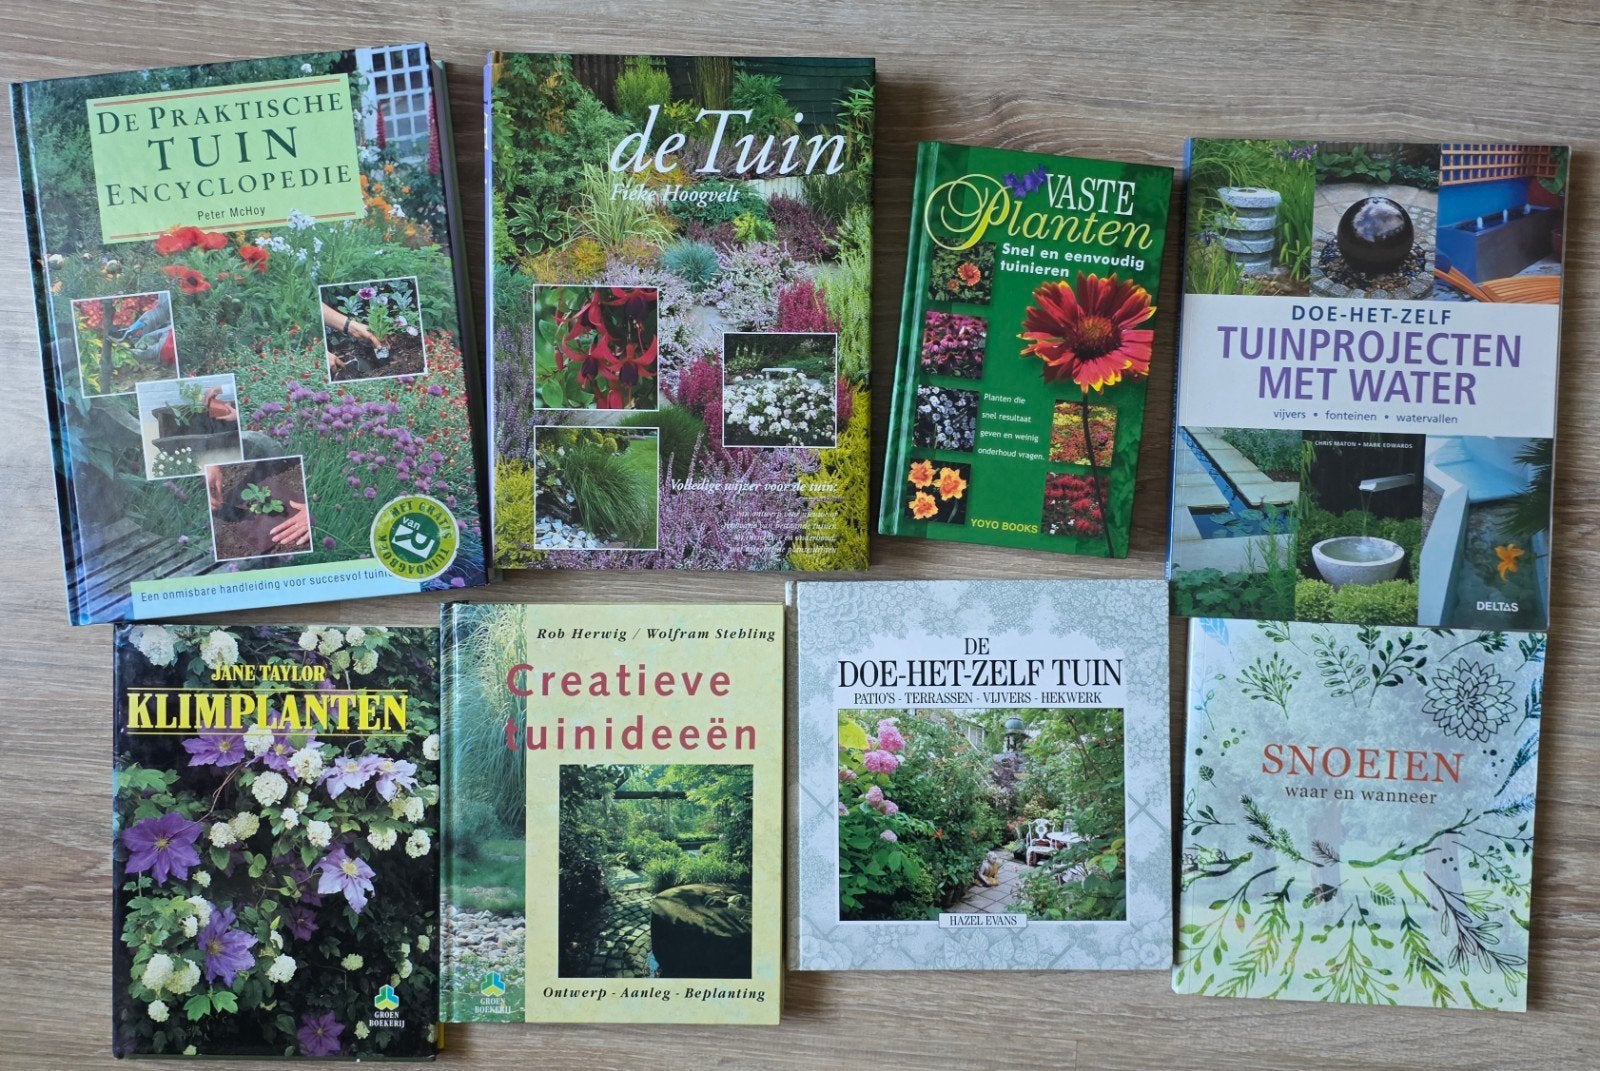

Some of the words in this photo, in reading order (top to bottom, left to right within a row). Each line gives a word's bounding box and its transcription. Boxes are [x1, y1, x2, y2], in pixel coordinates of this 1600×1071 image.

[610, 104, 686, 173] de
[694, 107, 847, 175] Tuin
[148, 126, 298, 171] TUIN
[610, 183, 656, 201] Fieke
[663, 184, 740, 207] Hoogvelt
[1045, 173, 1136, 216] VASTE
[197, 208, 225, 222] Peter
[230, 205, 266, 220] McHoy
[924, 173, 1153, 250] Planten
[1002, 242, 1035, 257] Snel
[1040, 249, 1060, 260] en
[1064, 251, 1145, 272] eenvoudig
[1000, 260, 1070, 278] tuinieren
[1291, 305, 1452, 326] DOE-HET-ZELF
[1216, 325, 1522, 368] TUINPROJECTEN
[1258, 366, 1337, 400] MET
[1348, 368, 1477, 405] WATER
[983, 393, 1012, 403] Planten
[1013, 396, 1026, 405] die
[981, 412, 997, 420] snel
[998, 414, 1032, 423] resultaat
[1273, 409, 1306, 421] vijvers
[1324, 410, 1377, 422] fonteinen
[1396, 413, 1458, 424] watervallen
[980, 430, 1002, 438] geven
[1015, 433, 1039, 443] weinig
[977, 447, 1017, 458] onderhoud
[1018, 452, 1045, 461] vragen.
[671, 478, 721, 494] Volledige
[724, 482, 759, 494] wijzer
[765, 483, 790, 492] voor
[792, 480, 807, 492] de
[390, 501, 413, 517] MET
[402, 517, 420, 530] van
[971, 518, 999, 529] YOYO
[1002, 521, 1038, 534] BOOKS
[141, 591, 160, 602] Een
[162, 586, 217, 600] onmisbare
[220, 579, 281, 595] handleiding
[283, 577, 306, 588] voor
[309, 569, 362, 586] succesvol
[1476, 601, 1519, 612] DELTAS
[537, 628, 566, 640] Rob
[571, 628, 627, 642] Herwig
[646, 628, 709, 642] Wolfram
[964, 637, 990, 655] DE
[211, 665, 255, 682] JANE
[259, 665, 326, 682] TAYLOR
[506, 663, 731, 698] Creatieve
[838, 659, 1045, 688] DOE-HET-ZELF
[1051, 659, 1123, 686] TUIN
[854, 692, 896, 705] PATIO'S
[904, 692, 973, 704] TERRASSEN
[983, 692, 1031, 704] VIJVERS
[1041, 692, 1102, 704] HEKWERK
[127, 693, 408, 730] KLIMPLANTEN
[504, 715, 756, 751] tuinideeën
[1262, 743, 1465, 784] SNOEIEN
[1285, 785, 1328, 799] waar
[1334, 788, 1354, 800] en
[1360, 790, 1437, 805] wanneer
[950, 915, 983, 926] HAZEL
[986, 915, 1017, 926] EVANS
[480, 997, 506, 1005] GROEN
[543, 987, 607, 1001] Ontwerp
[620, 987, 671, 1001] Aanleg
[685, 987, 766, 1002] Beplanting
[369, 1019, 405, 1028] BOEKERIJ
[374, 1011, 400, 1019] GROEN
